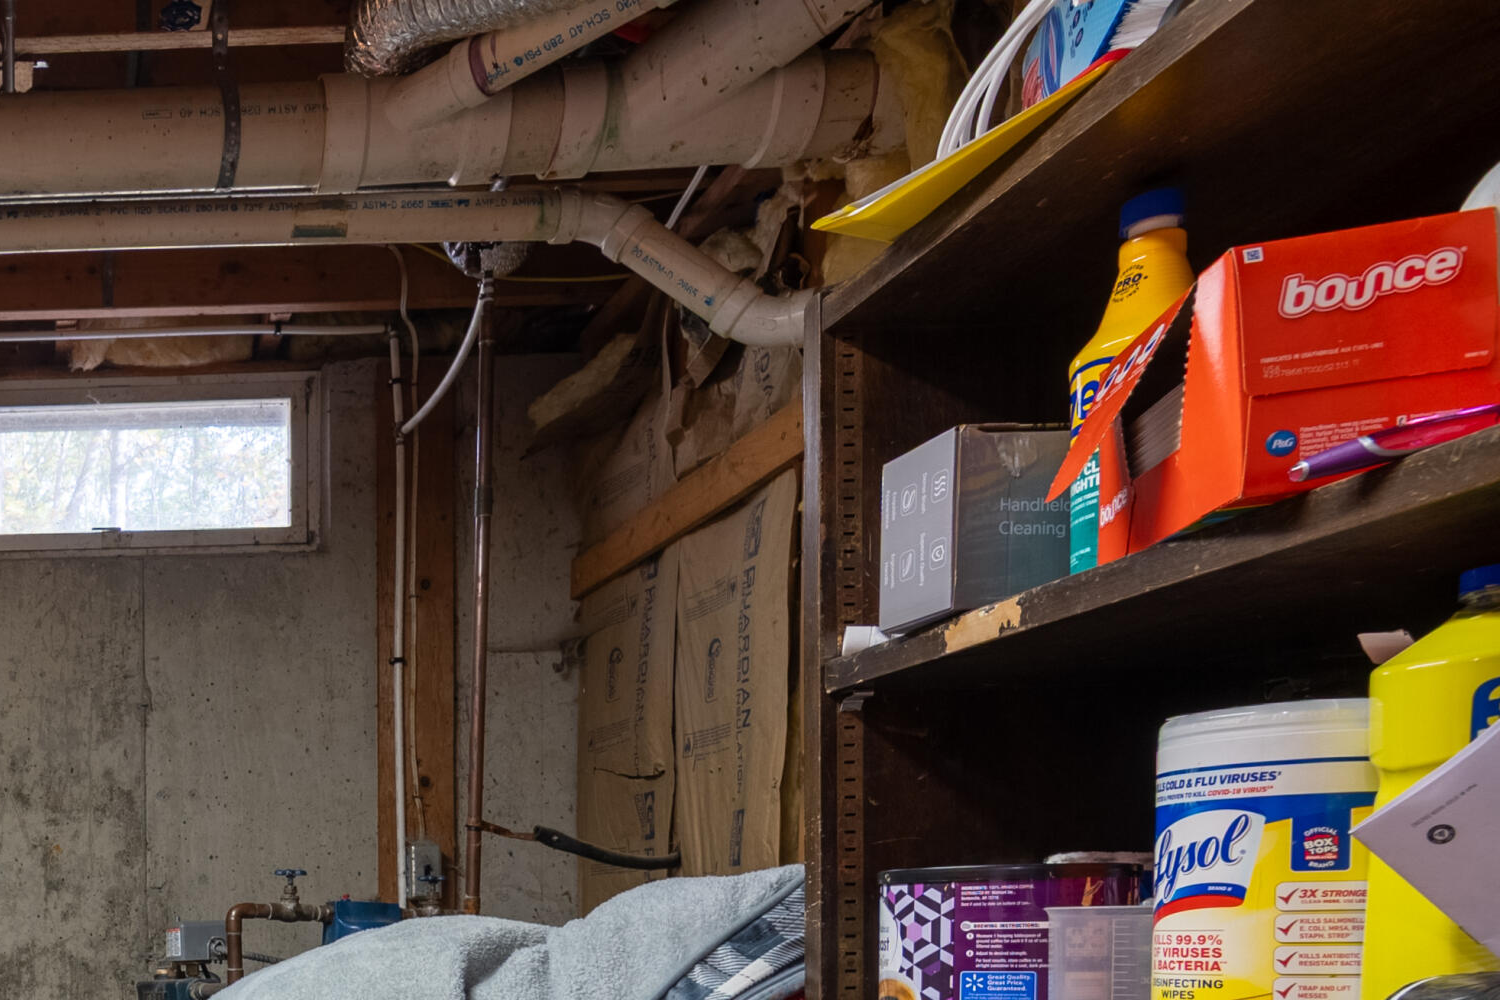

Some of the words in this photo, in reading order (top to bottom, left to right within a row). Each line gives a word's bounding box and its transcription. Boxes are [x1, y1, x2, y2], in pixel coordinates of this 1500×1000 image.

[569, 9, 611, 39] SCH.40
[543, 34, 565, 52] 280
[524, 47, 542, 62] PSI
[268, 104, 298, 114] ASTM
[1116, 272, 1143, 290] PRO
[1279, 247, 1464, 318] bounce
[1271, 437, 1295, 449] P&G
[998, 520, 1066, 538] Cleaning
[739, 565, 756, 728] GUARDIAN
[1165, 781, 1185, 792] COLD
[1186, 778, 1193, 789] &
[1194, 775, 1217, 788] FLU
[1302, 826, 1339, 836] OFFICIAL
[1303, 836, 1334, 849] BOX
[1154, 812, 1252, 900] Lysol
[1309, 845, 1339, 855] TOPS
[1299, 889, 1319, 898] 3X
[1322, 889, 1367, 898] STRONGE
[1175, 934, 1223, 946] 99.9%
[1162, 947, 1223, 959] VIRUSES
[1161, 990, 1195, 1000] WIPES
